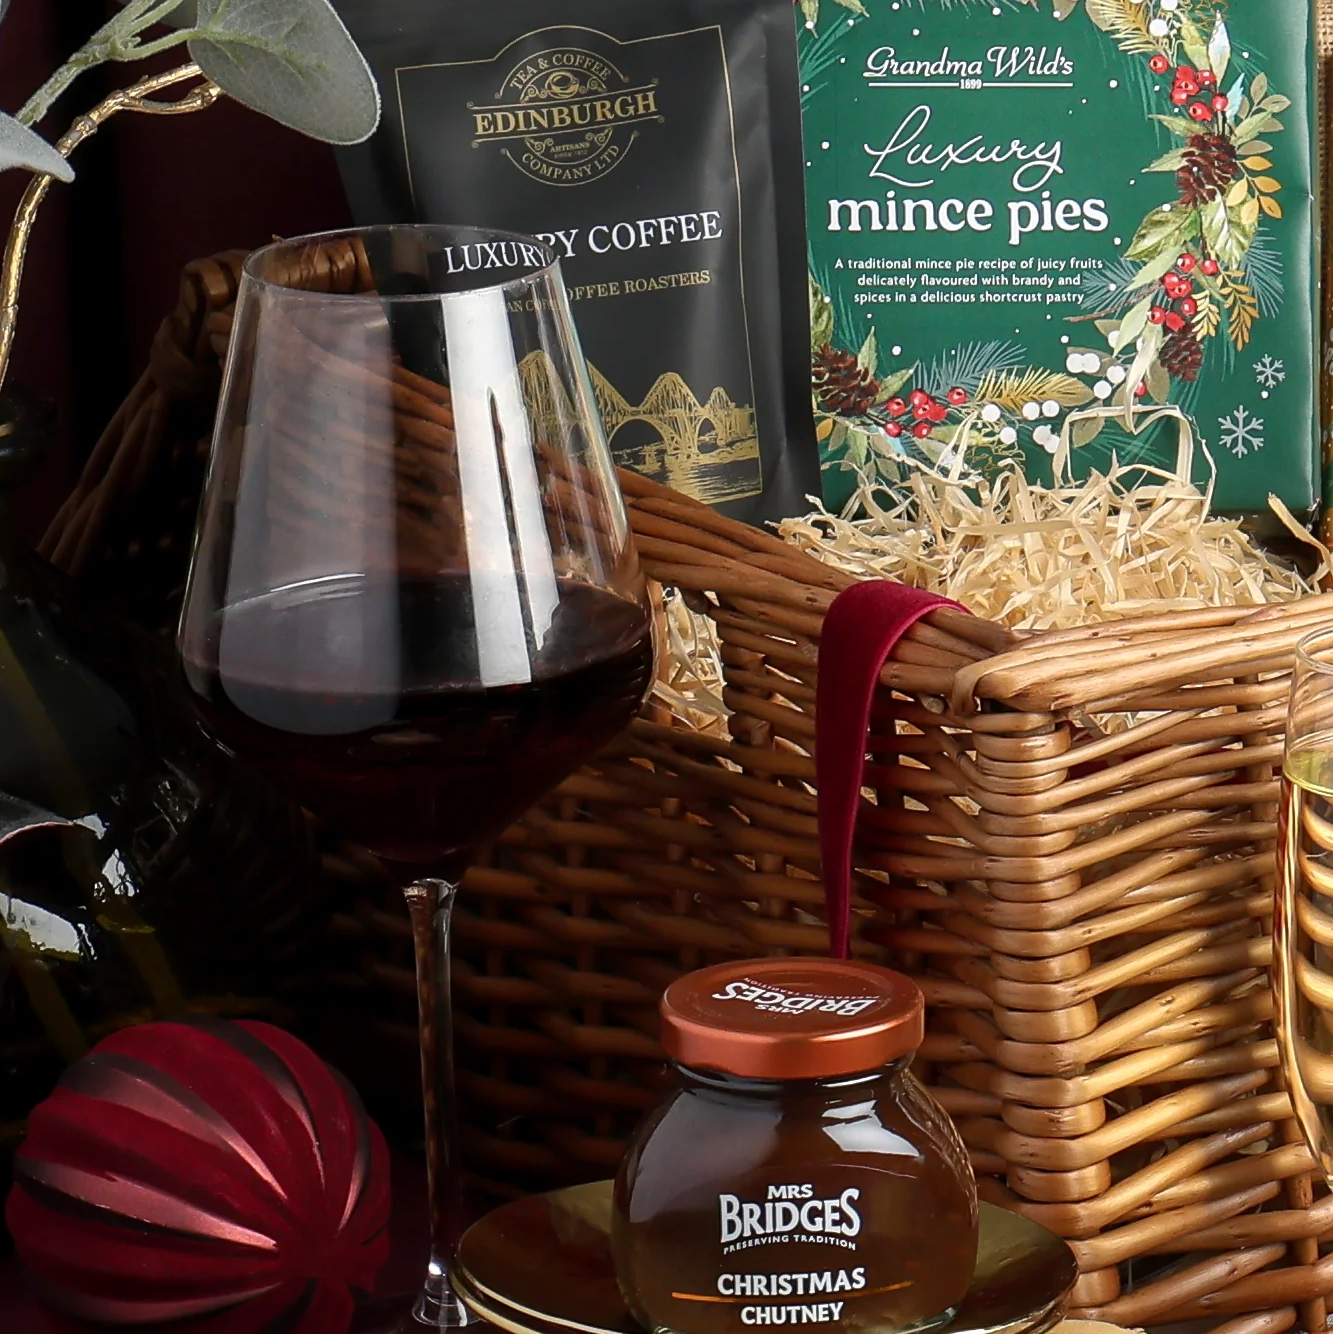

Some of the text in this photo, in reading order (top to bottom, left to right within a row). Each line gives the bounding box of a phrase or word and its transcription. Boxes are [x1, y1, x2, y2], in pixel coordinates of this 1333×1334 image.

[863, 47, 1073, 78] Grandma Wild's
[960, 79, 983, 89] 1899
[473, 91, 658, 136] EDINBURGH
[865, 105, 1063, 190] Luxury
[588, 211, 723, 253] COFFEE
[828, 190, 1109, 245] mince pies
[835, 257, 1103, 273] A traditional mince pie recipe of juicy fruits
[624, 270, 710, 292] ROASTERS
[767, 1185, 813, 1199] MRS
[719, 1188, 860, 1243] BRIDGES
[723, 1234, 856, 1254] PRESERVING TRADITION
[717, 1267, 866, 1296] CHRISTMAS
[741, 1302, 843, 1325] CHUTNEY
